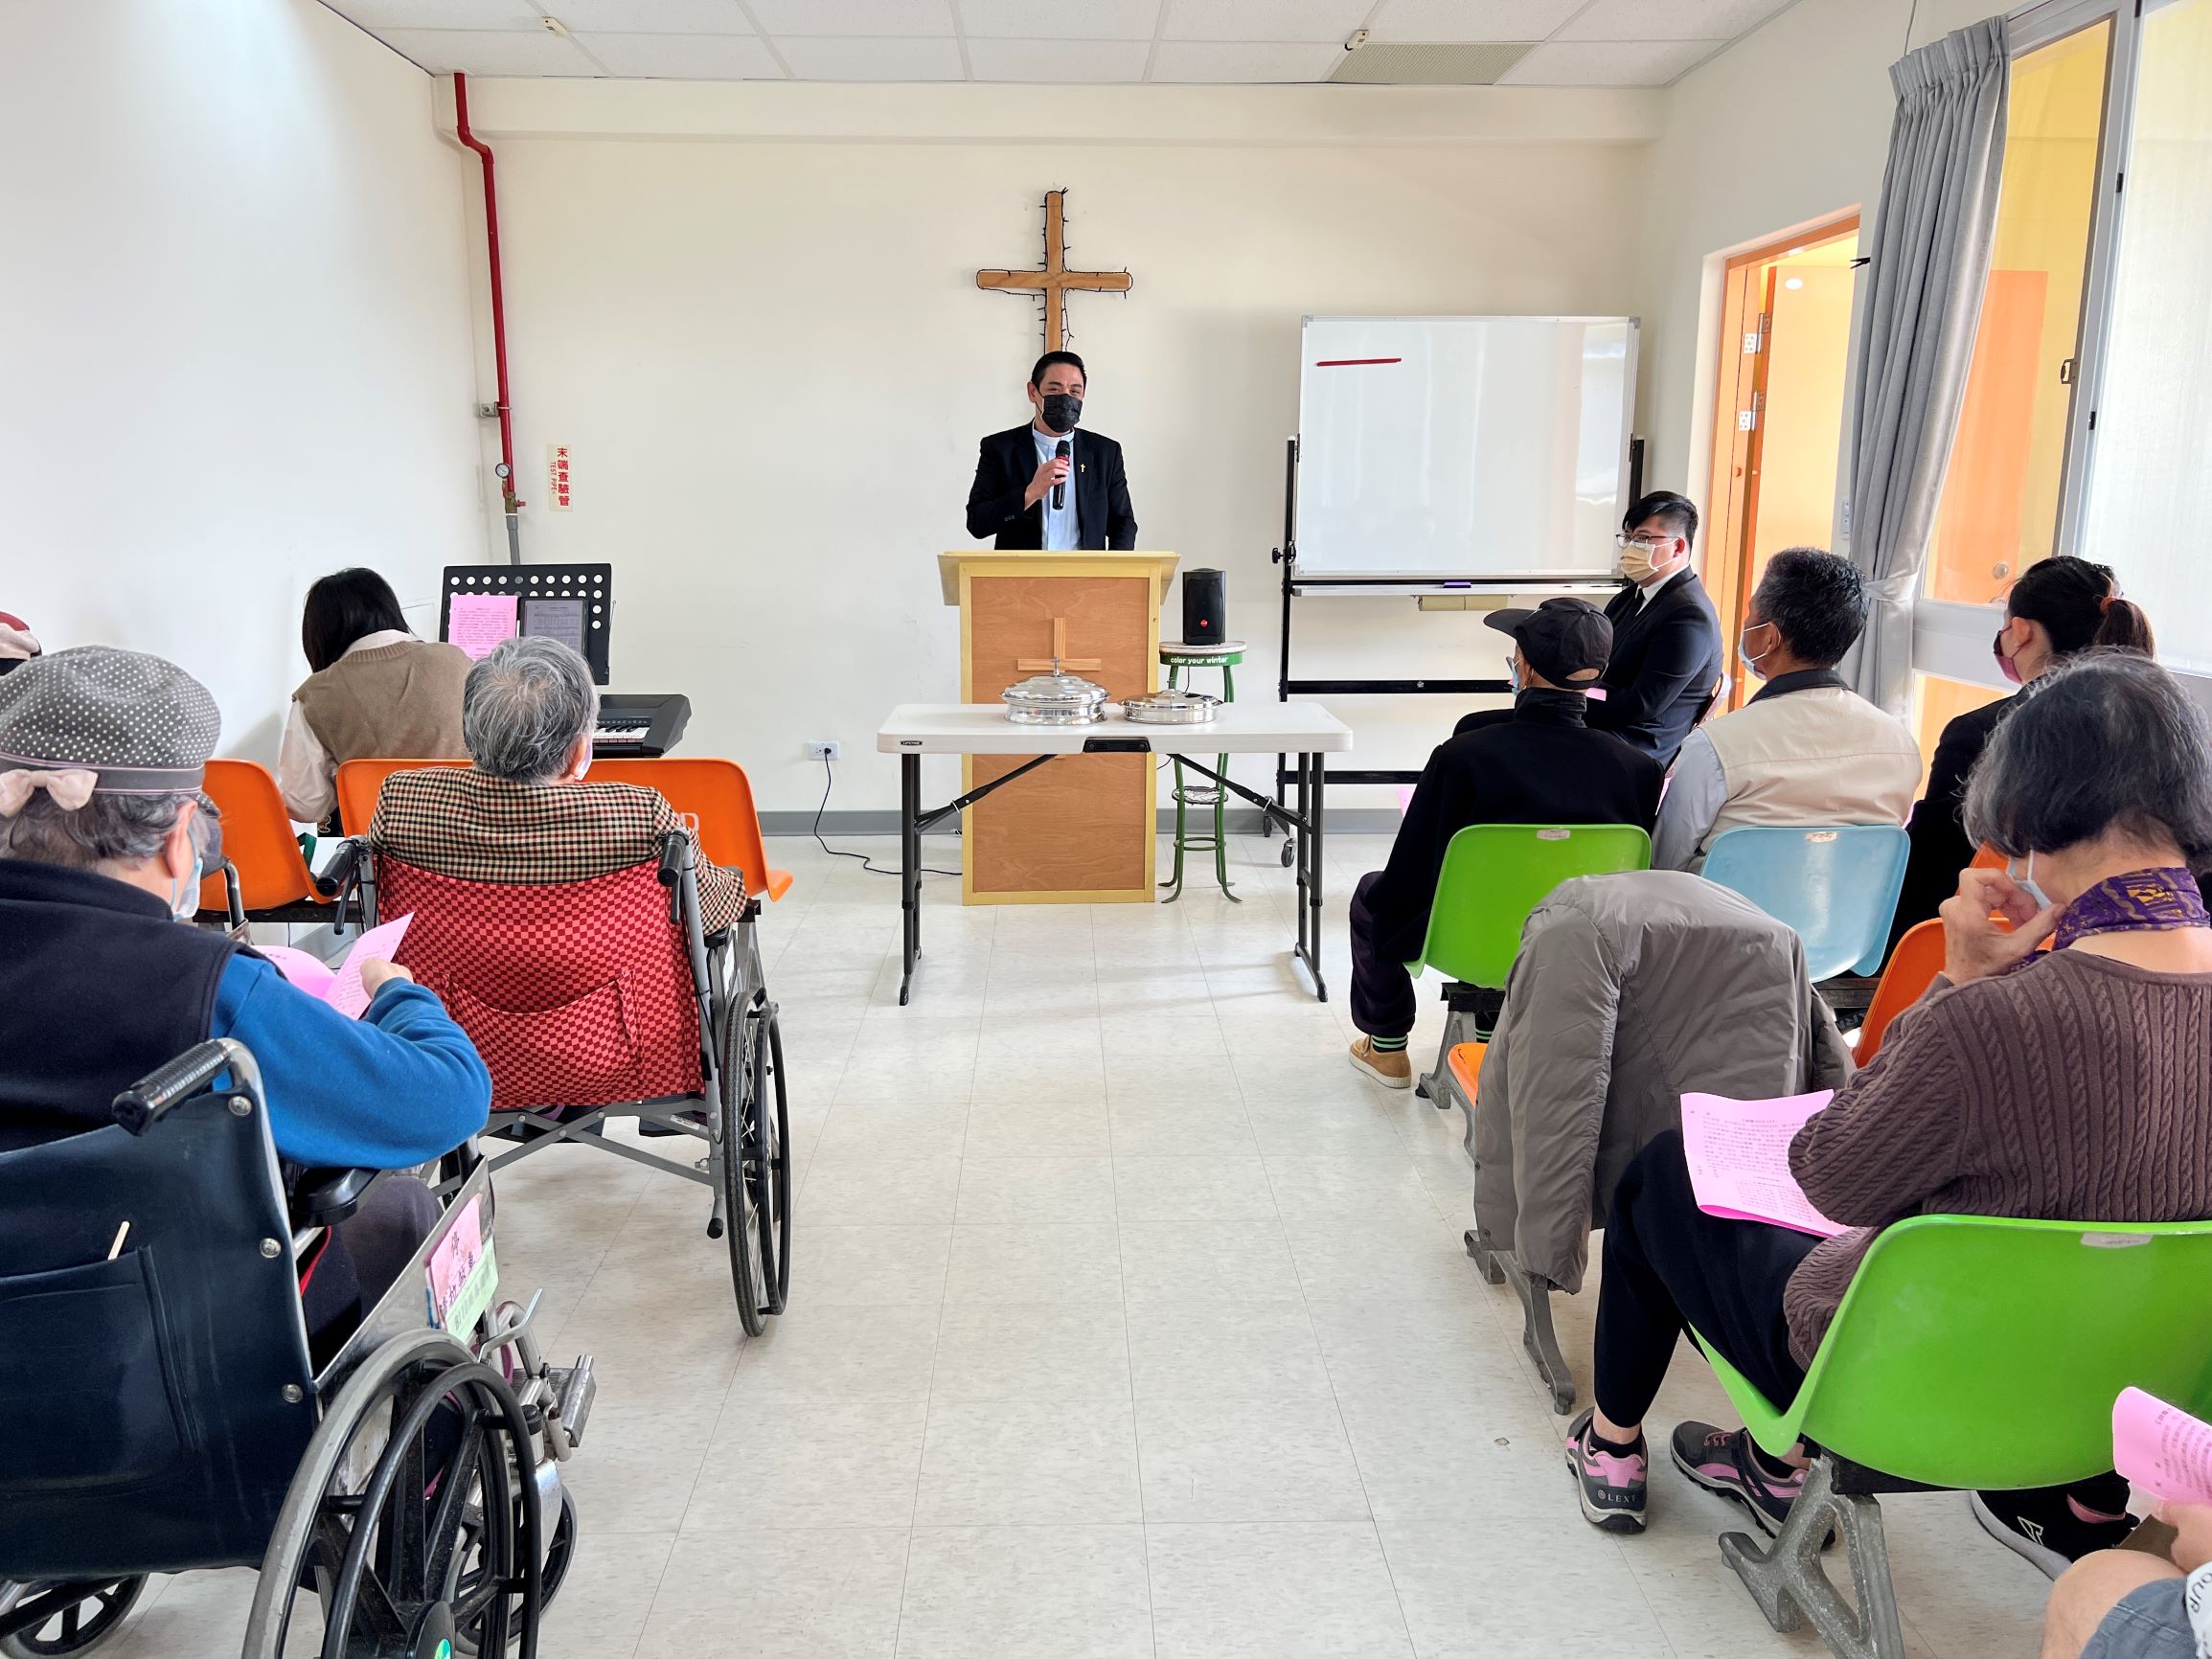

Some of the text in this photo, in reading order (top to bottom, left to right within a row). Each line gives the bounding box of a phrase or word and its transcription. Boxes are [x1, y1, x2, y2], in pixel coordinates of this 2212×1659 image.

[557, 447, 570, 507] 末端查驗管
